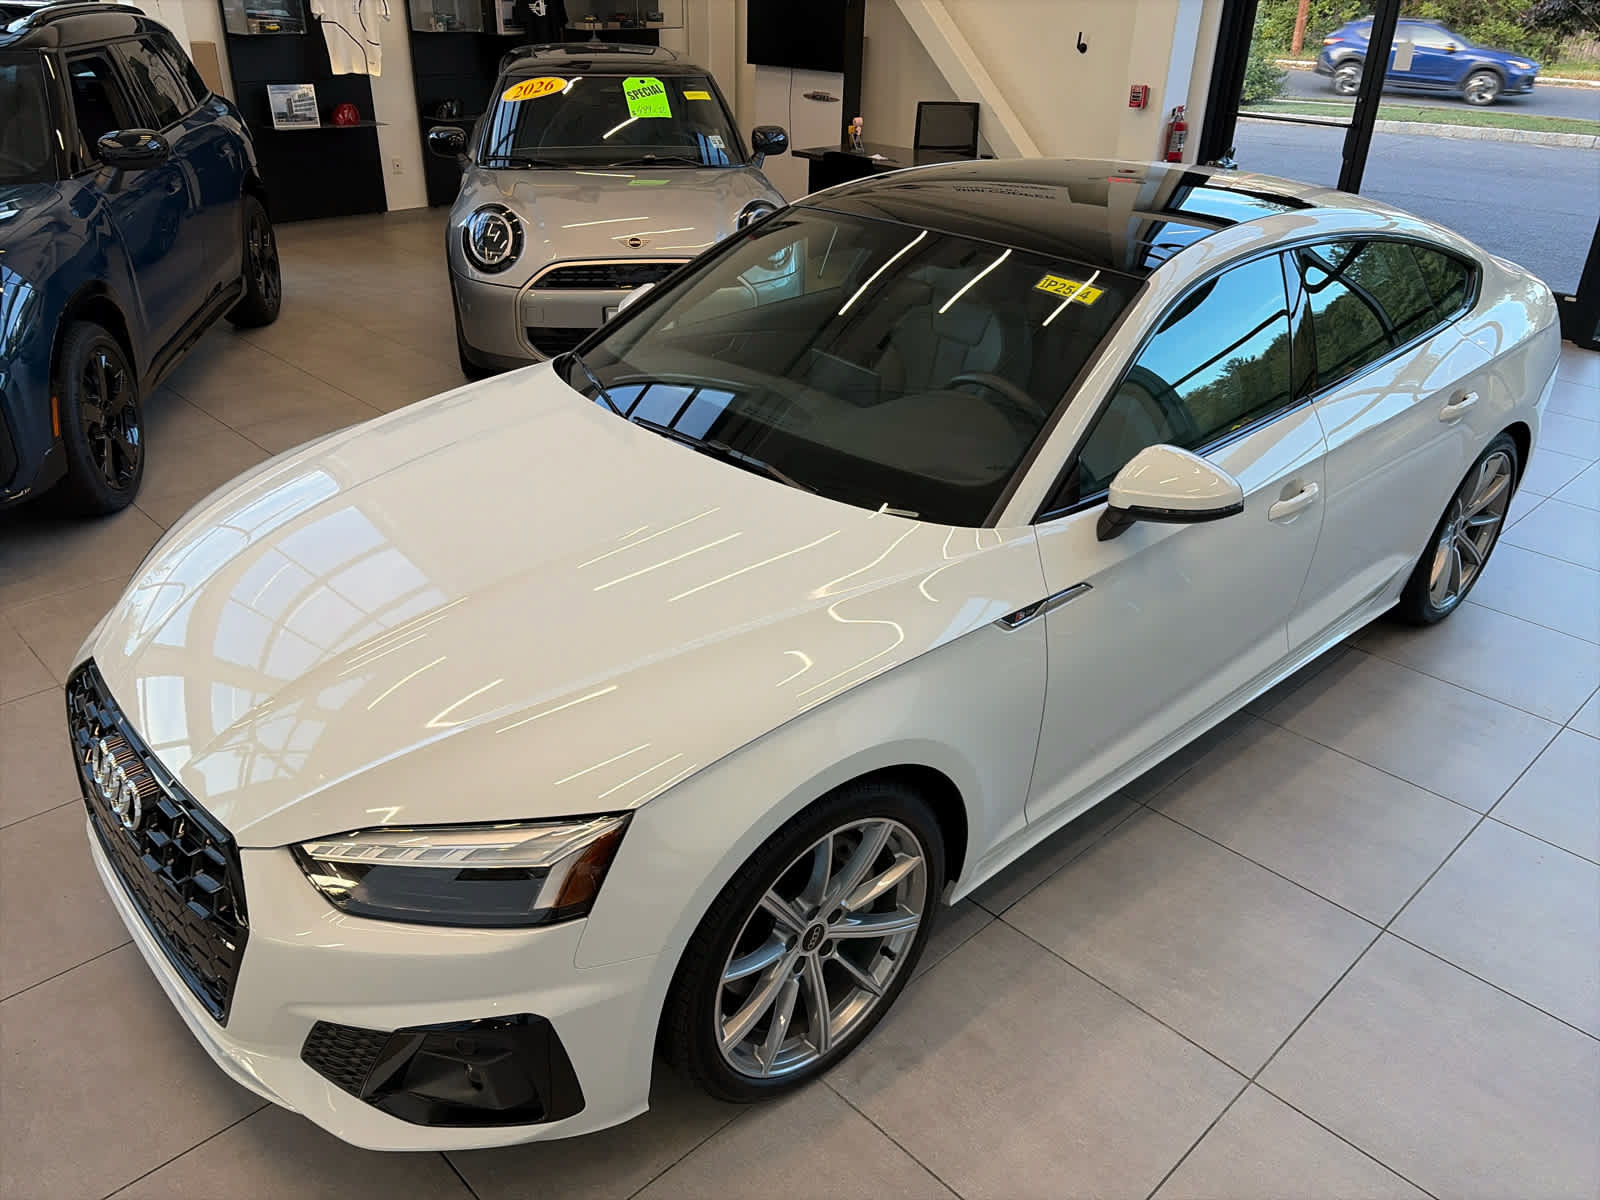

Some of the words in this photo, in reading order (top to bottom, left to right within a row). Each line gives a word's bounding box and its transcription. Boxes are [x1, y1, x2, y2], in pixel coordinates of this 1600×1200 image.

[512, 80, 554, 99] 2026
[626, 84, 664, 100] SPECIAL
[1040, 278, 1091, 300] IP254
